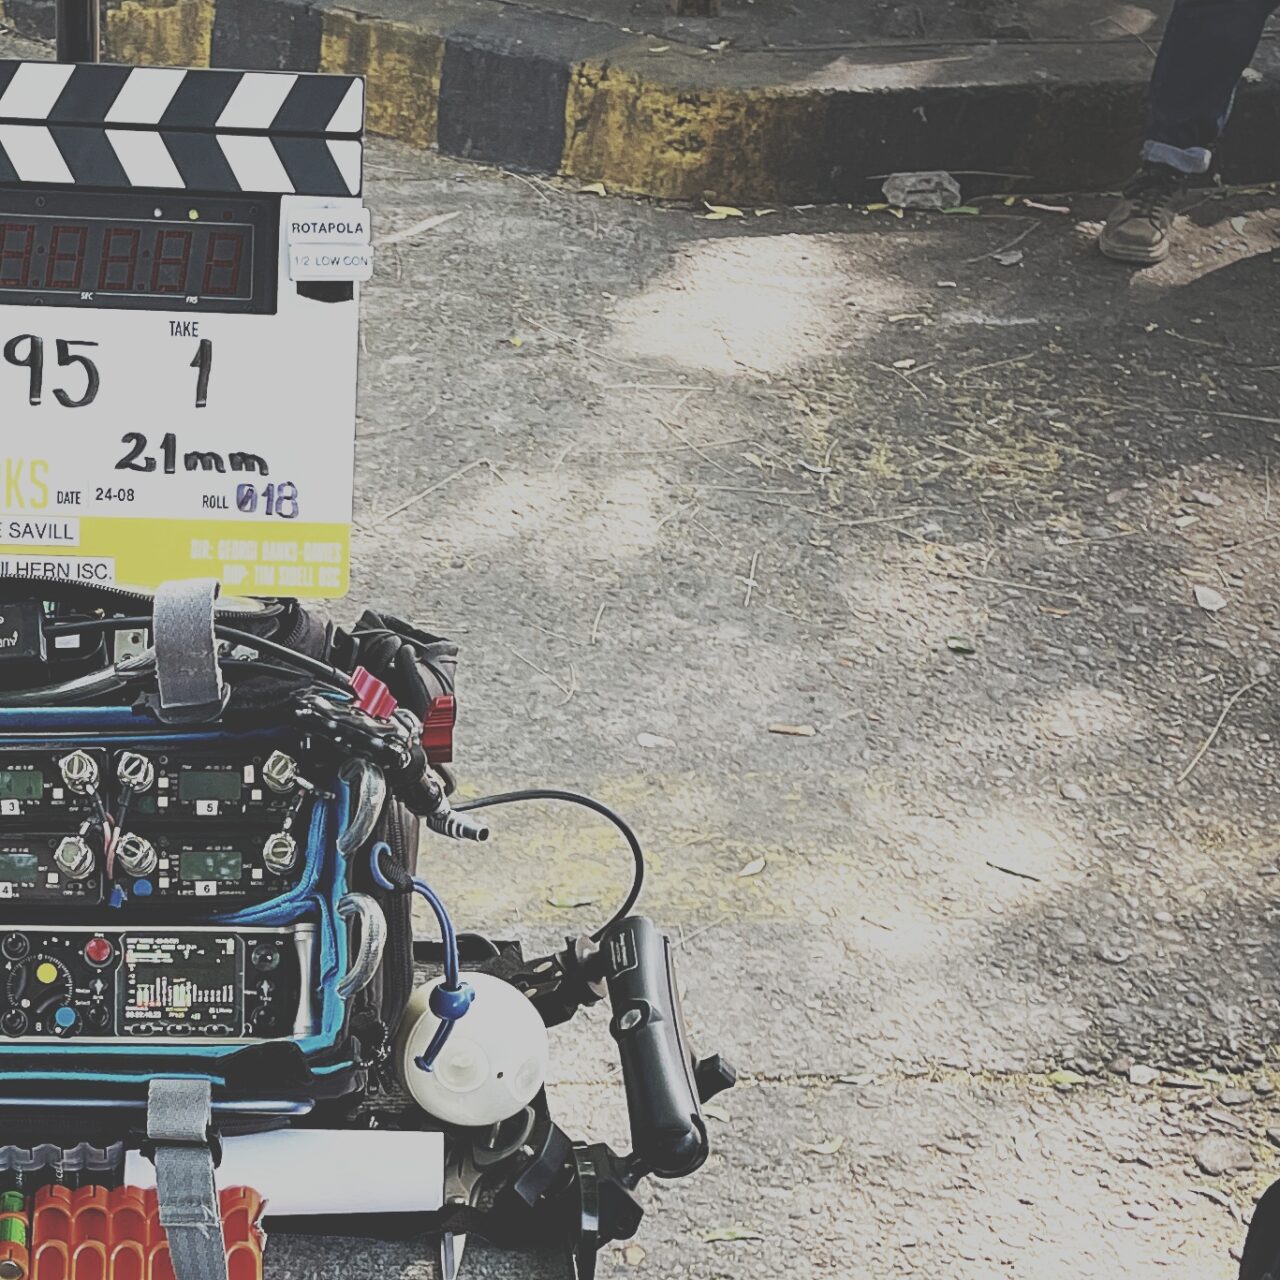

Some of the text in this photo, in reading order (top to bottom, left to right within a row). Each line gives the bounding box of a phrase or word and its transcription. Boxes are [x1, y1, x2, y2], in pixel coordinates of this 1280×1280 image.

[291, 222, 364, 234] ROTAPOLA
[315, 255, 340, 266] LOW
[169, 320, 199, 338] TAKE
[189, 338, 213, 408] 1
[114, 431, 270, 476] 21mm
[56, 490, 81, 505] DATE
[95, 487, 135, 502] 24-08
[202, 494, 229, 510] ROLL
[8, 521, 75, 541] SAVILL
[76, 563, 113, 581] ISC.
[8, 802, 15, 812] 3
[206, 803, 213, 813] 5
[1, 885, 9, 894] 4
[203, 884, 210, 894] 6
